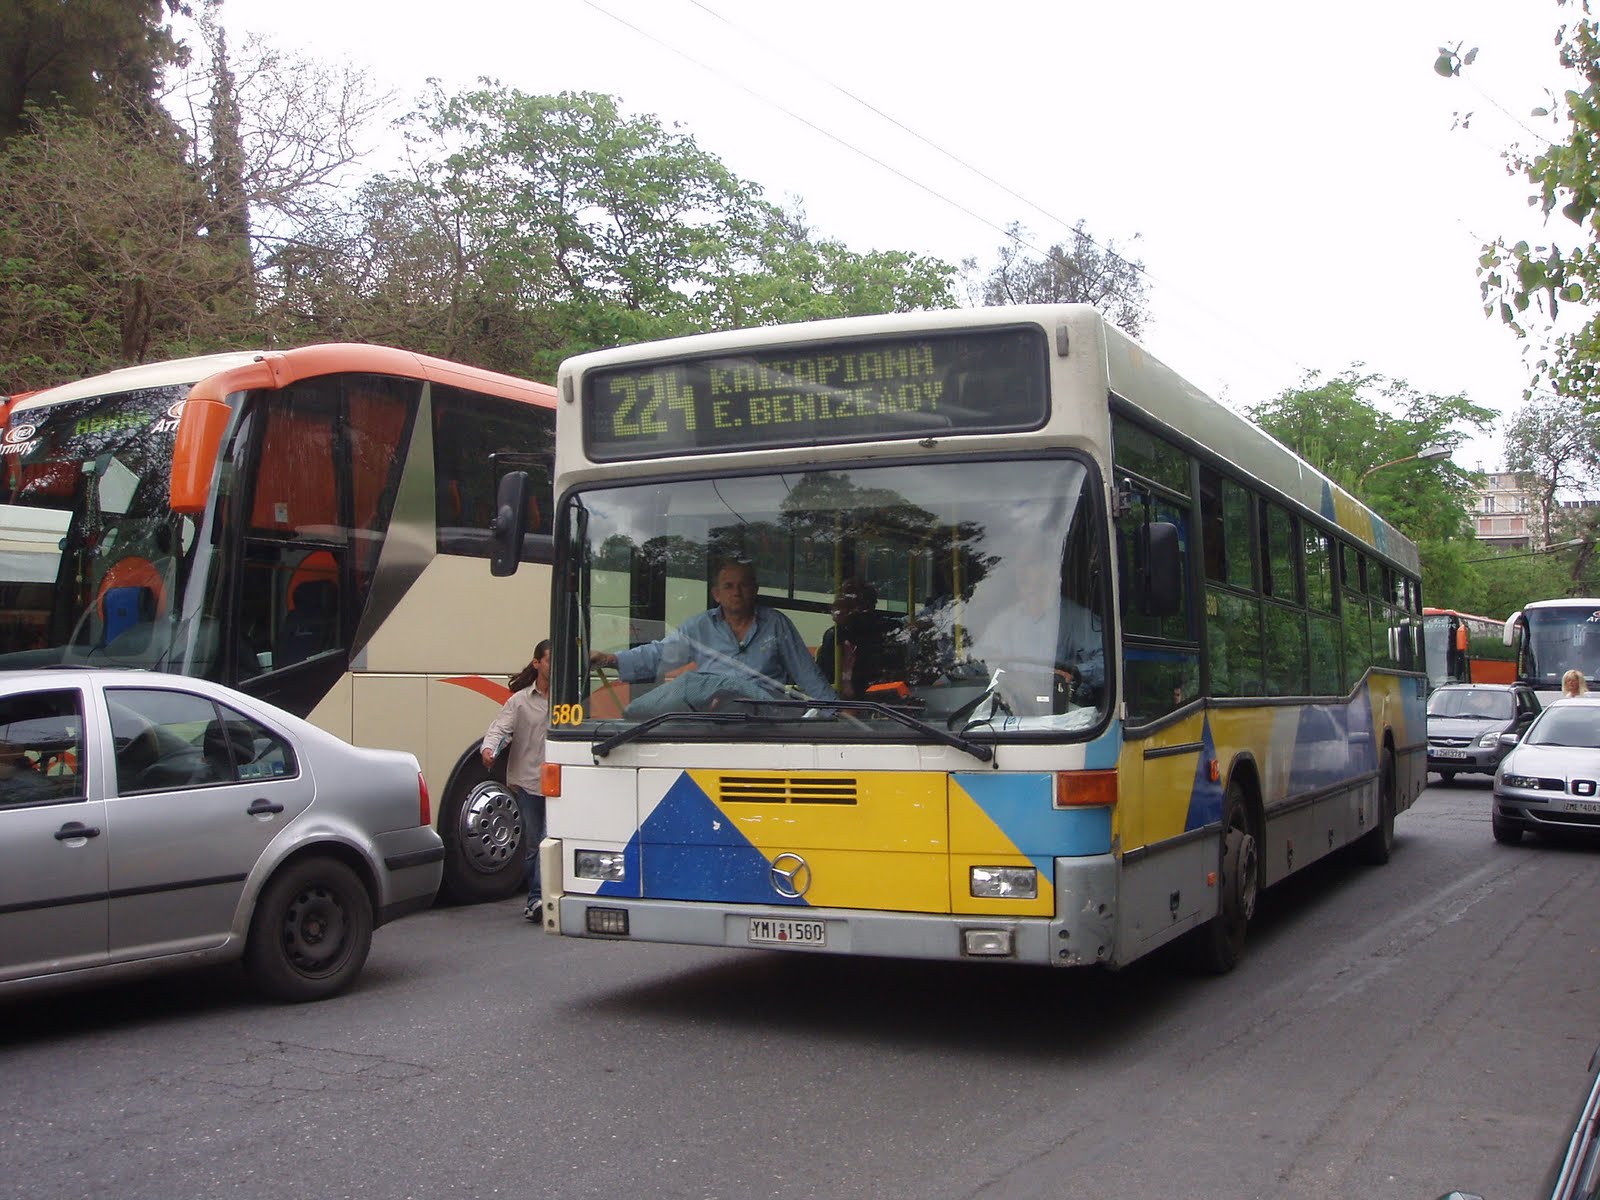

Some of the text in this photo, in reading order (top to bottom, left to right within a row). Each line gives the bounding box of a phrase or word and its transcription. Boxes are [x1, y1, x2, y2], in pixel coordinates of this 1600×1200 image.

[609, 371, 697, 436] 224
[552, 703, 583, 726] 580
[753, 921, 822, 940] YMI 1580
